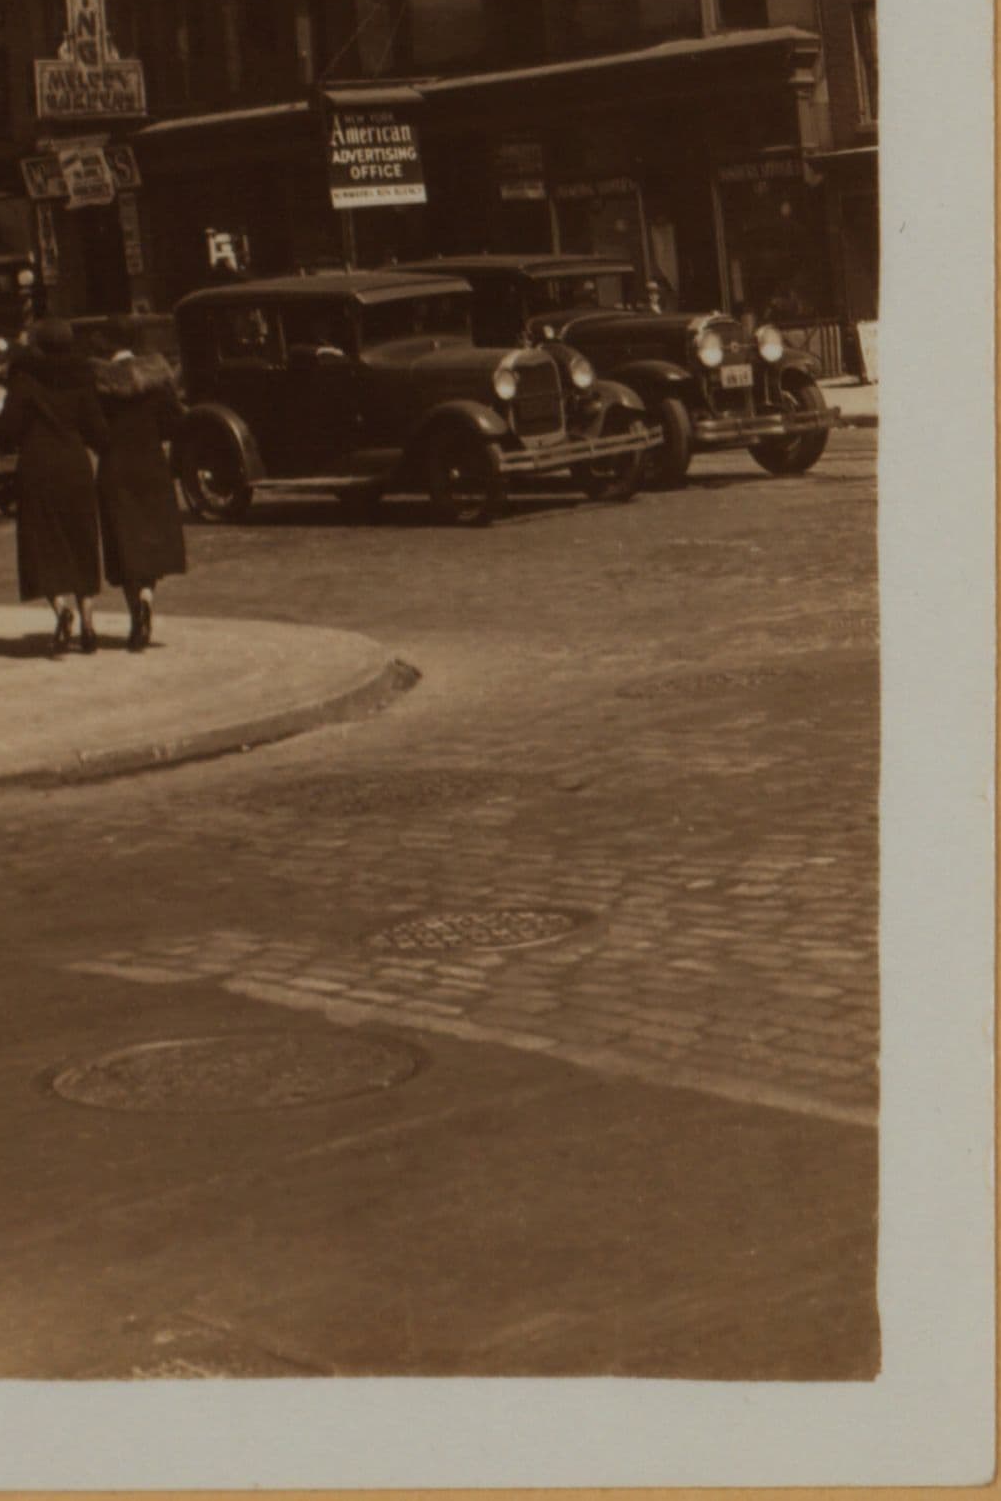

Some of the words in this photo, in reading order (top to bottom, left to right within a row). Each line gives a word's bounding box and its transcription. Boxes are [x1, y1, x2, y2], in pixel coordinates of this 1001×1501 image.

[329, 113, 412, 147] American
[331, 147, 418, 165] ADVERTISING
[350, 163, 404, 180] OFFICE
